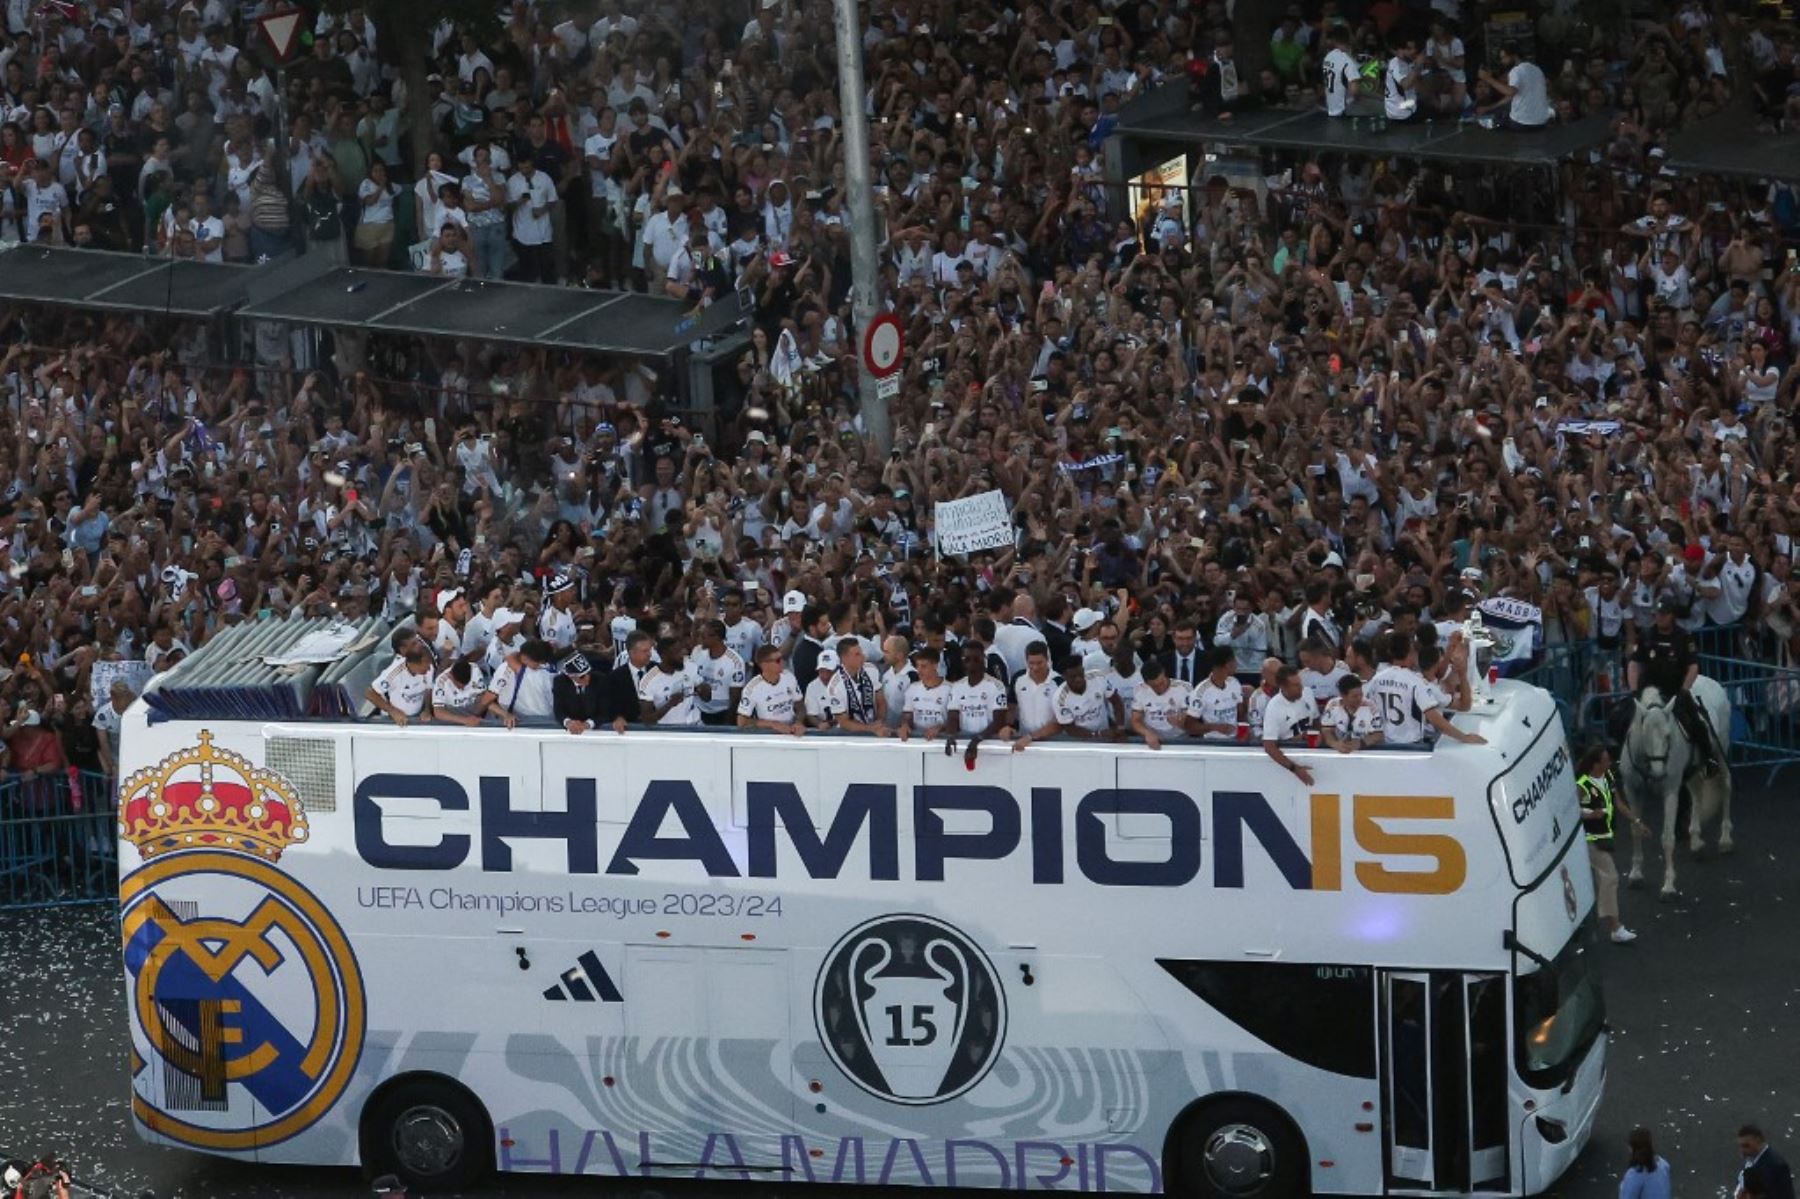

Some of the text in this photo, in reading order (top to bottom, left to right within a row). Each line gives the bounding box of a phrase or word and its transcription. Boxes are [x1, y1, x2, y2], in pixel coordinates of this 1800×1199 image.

[1378, 692, 1405, 727] 15
[357, 887, 783, 920] UEFA Champions League 2023/24
[885, 1004, 938, 1047] 15
[780, 1134, 1165, 1194] MADRID
